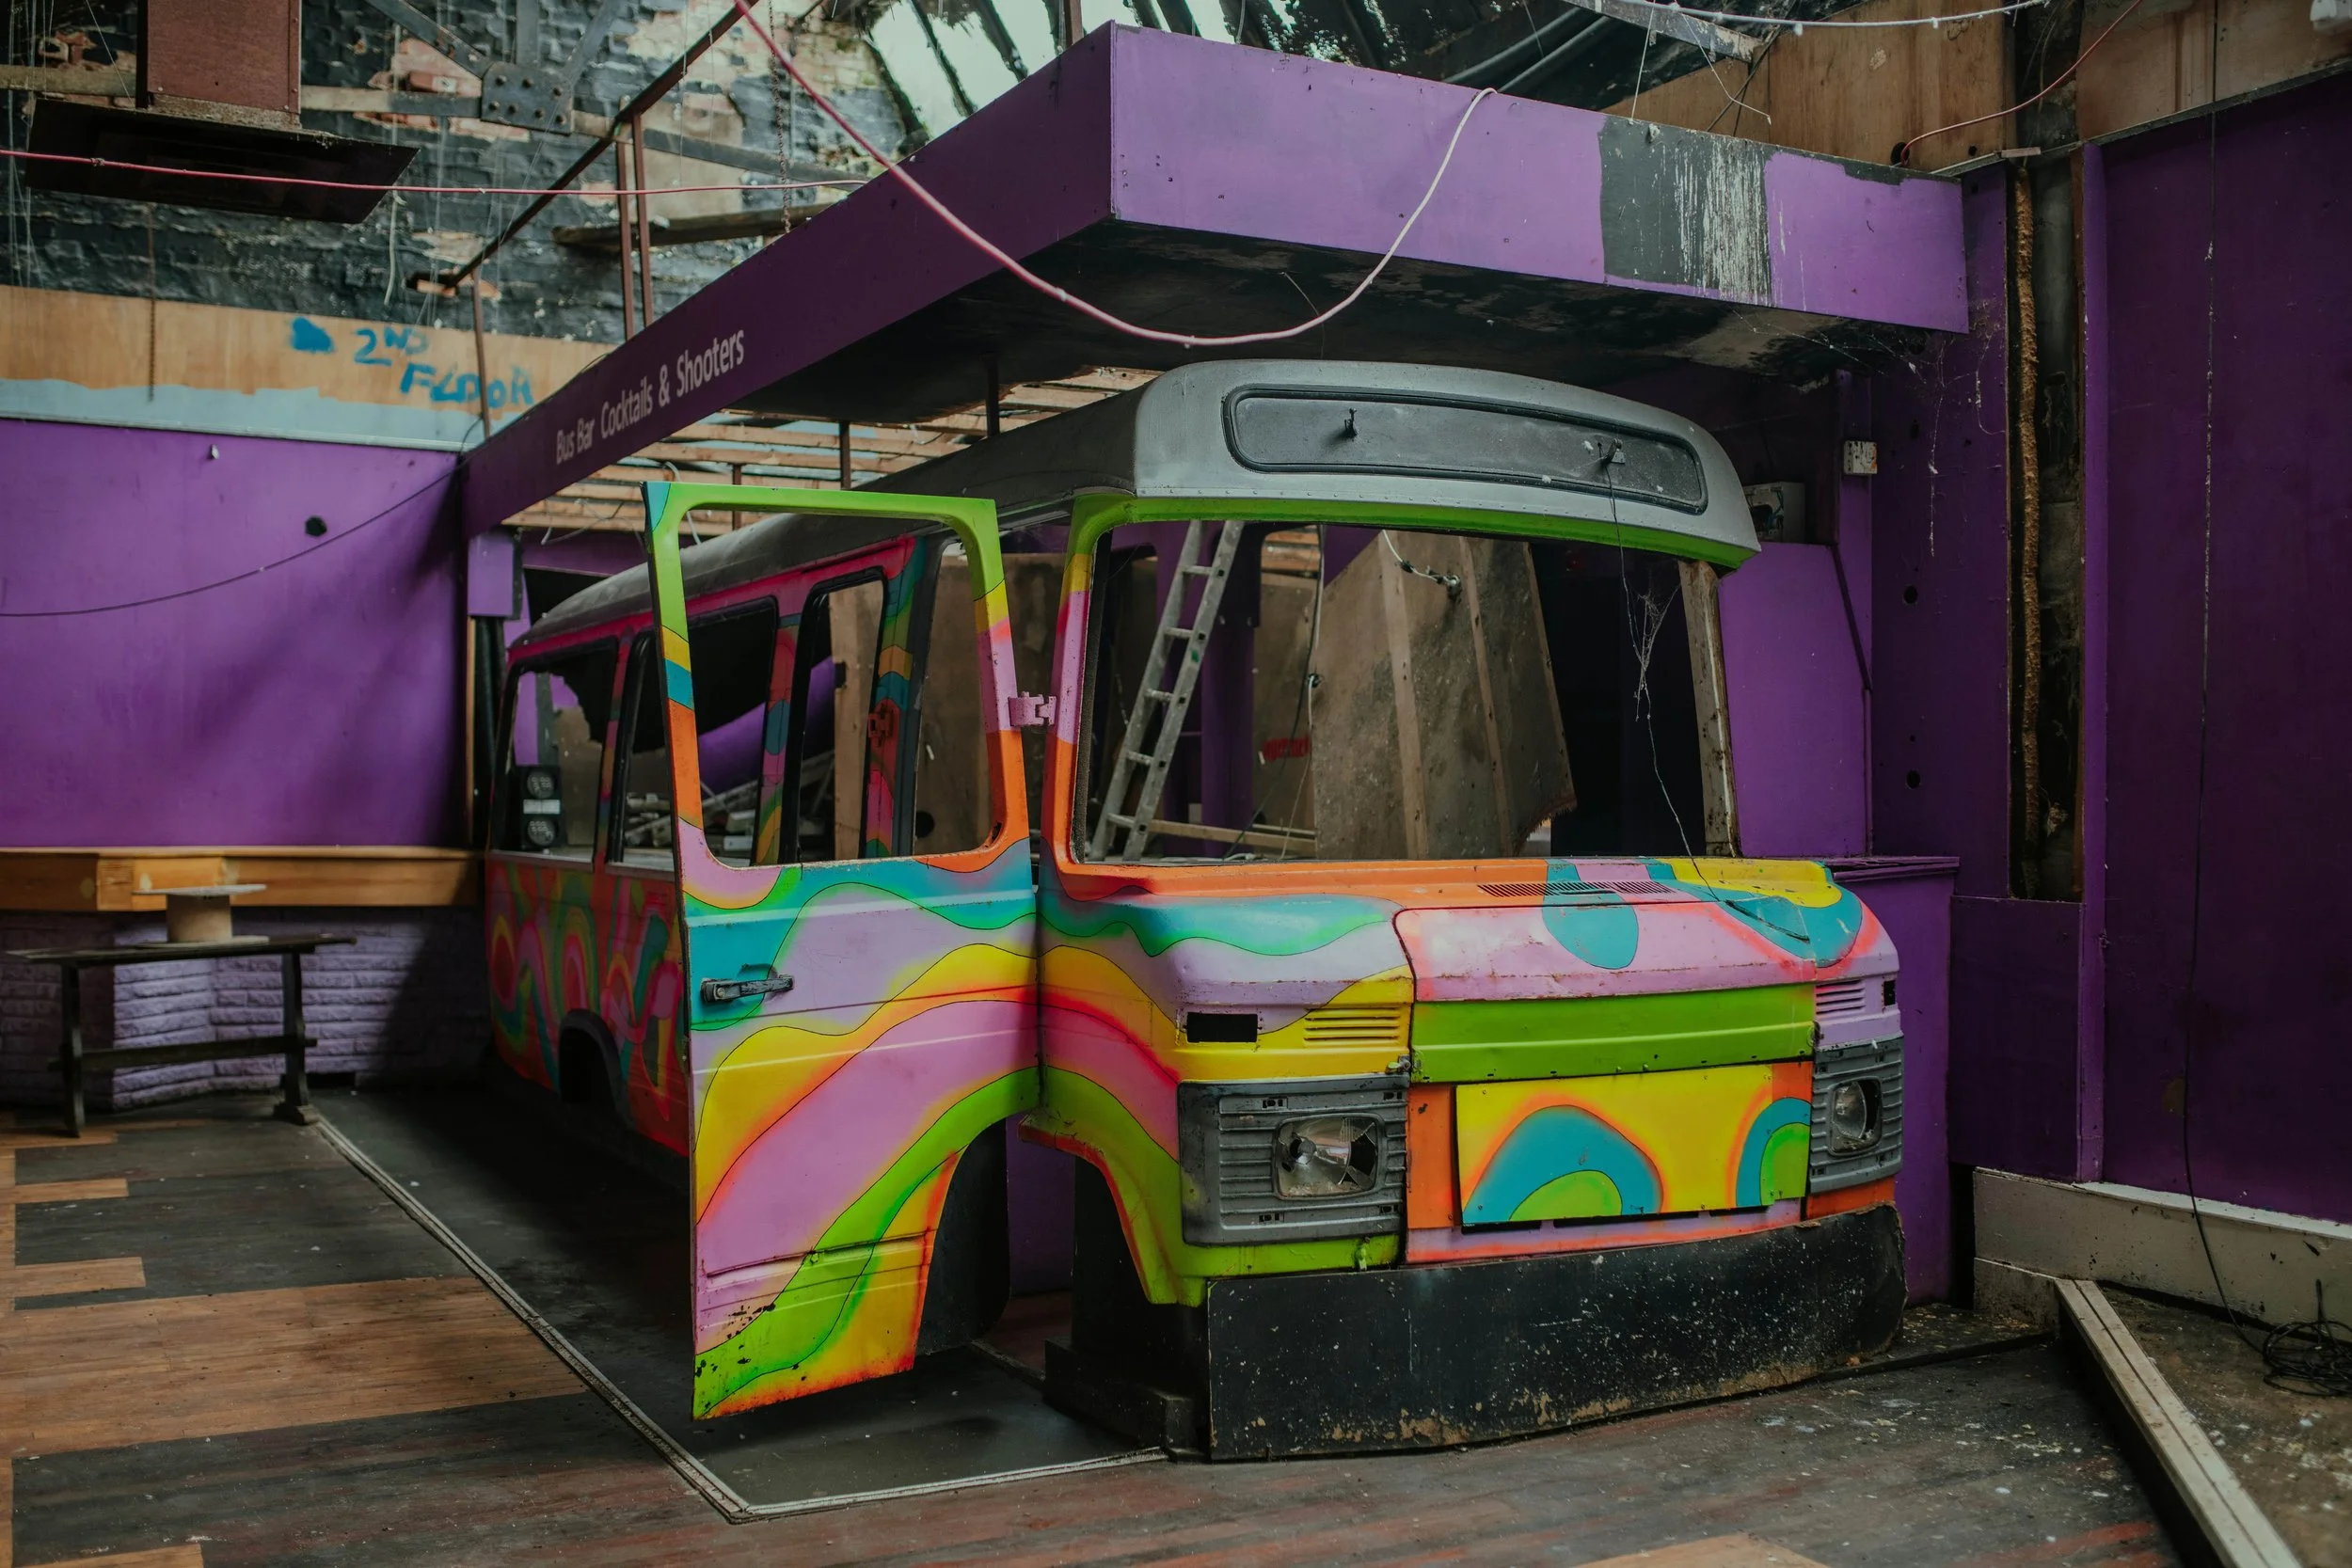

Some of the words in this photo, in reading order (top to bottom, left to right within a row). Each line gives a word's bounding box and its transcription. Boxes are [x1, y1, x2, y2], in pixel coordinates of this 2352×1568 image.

[399, 362, 534, 409] FLOOR
[557, 430, 575, 465] Bus
[577, 418, 595, 452] Bar
[601, 376, 653, 438] Cocktails
[659, 364, 670, 407] &
[676, 330, 744, 397] Shooters
